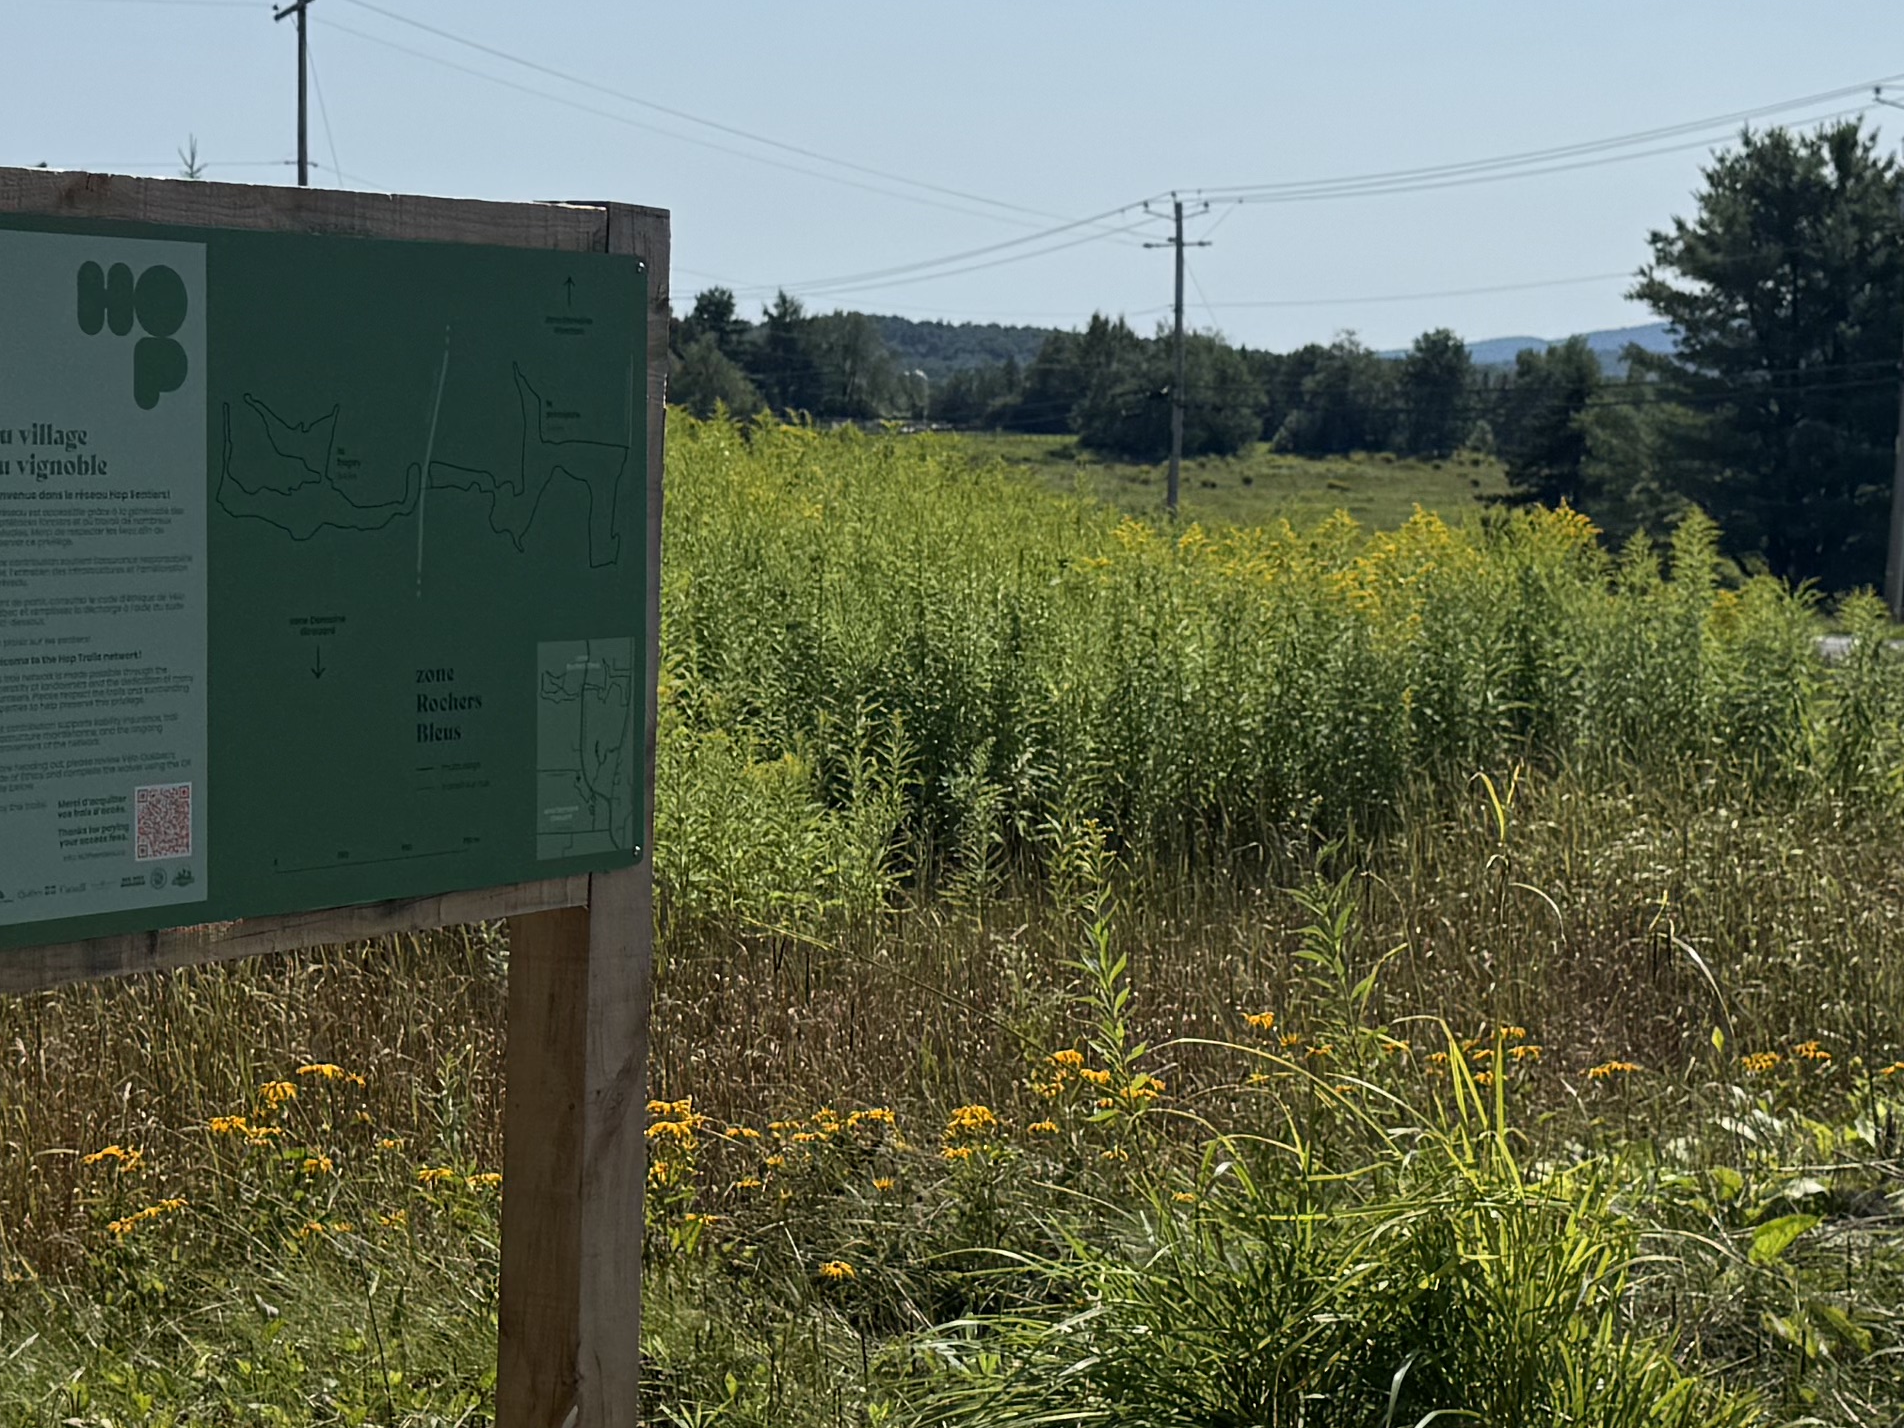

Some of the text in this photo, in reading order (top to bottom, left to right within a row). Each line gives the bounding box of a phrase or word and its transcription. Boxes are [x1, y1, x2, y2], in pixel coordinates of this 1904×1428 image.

[18, 422, 87, 452] village
[17, 452, 107, 482] vignoble
[416, 666, 455, 685] zone
[416, 692, 482, 714] Rochers
[416, 722, 462, 744] Bleus
